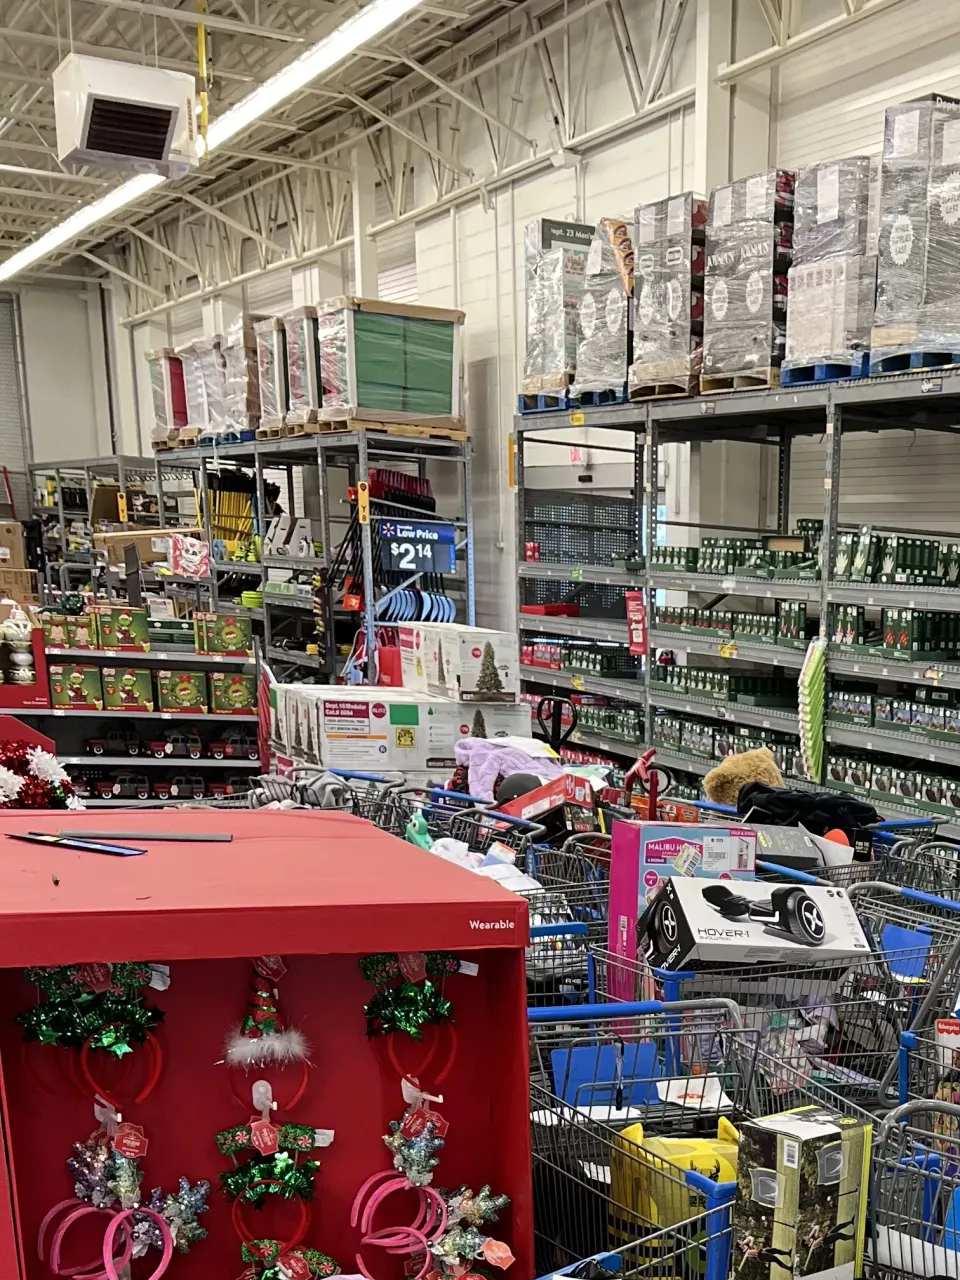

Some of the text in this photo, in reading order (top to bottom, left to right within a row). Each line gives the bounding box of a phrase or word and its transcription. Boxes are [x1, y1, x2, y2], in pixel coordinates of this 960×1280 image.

[566, 228, 575, 238] 23
[361, 514, 367, 522] 8
[397, 529, 439, 540] Low Price
[648, 843, 675, 851] MALIBU
[469, 920, 515, 929] Wearable
[698, 928, 750, 938] HOVER-1
[660, 944, 682, 971] OVER-1
